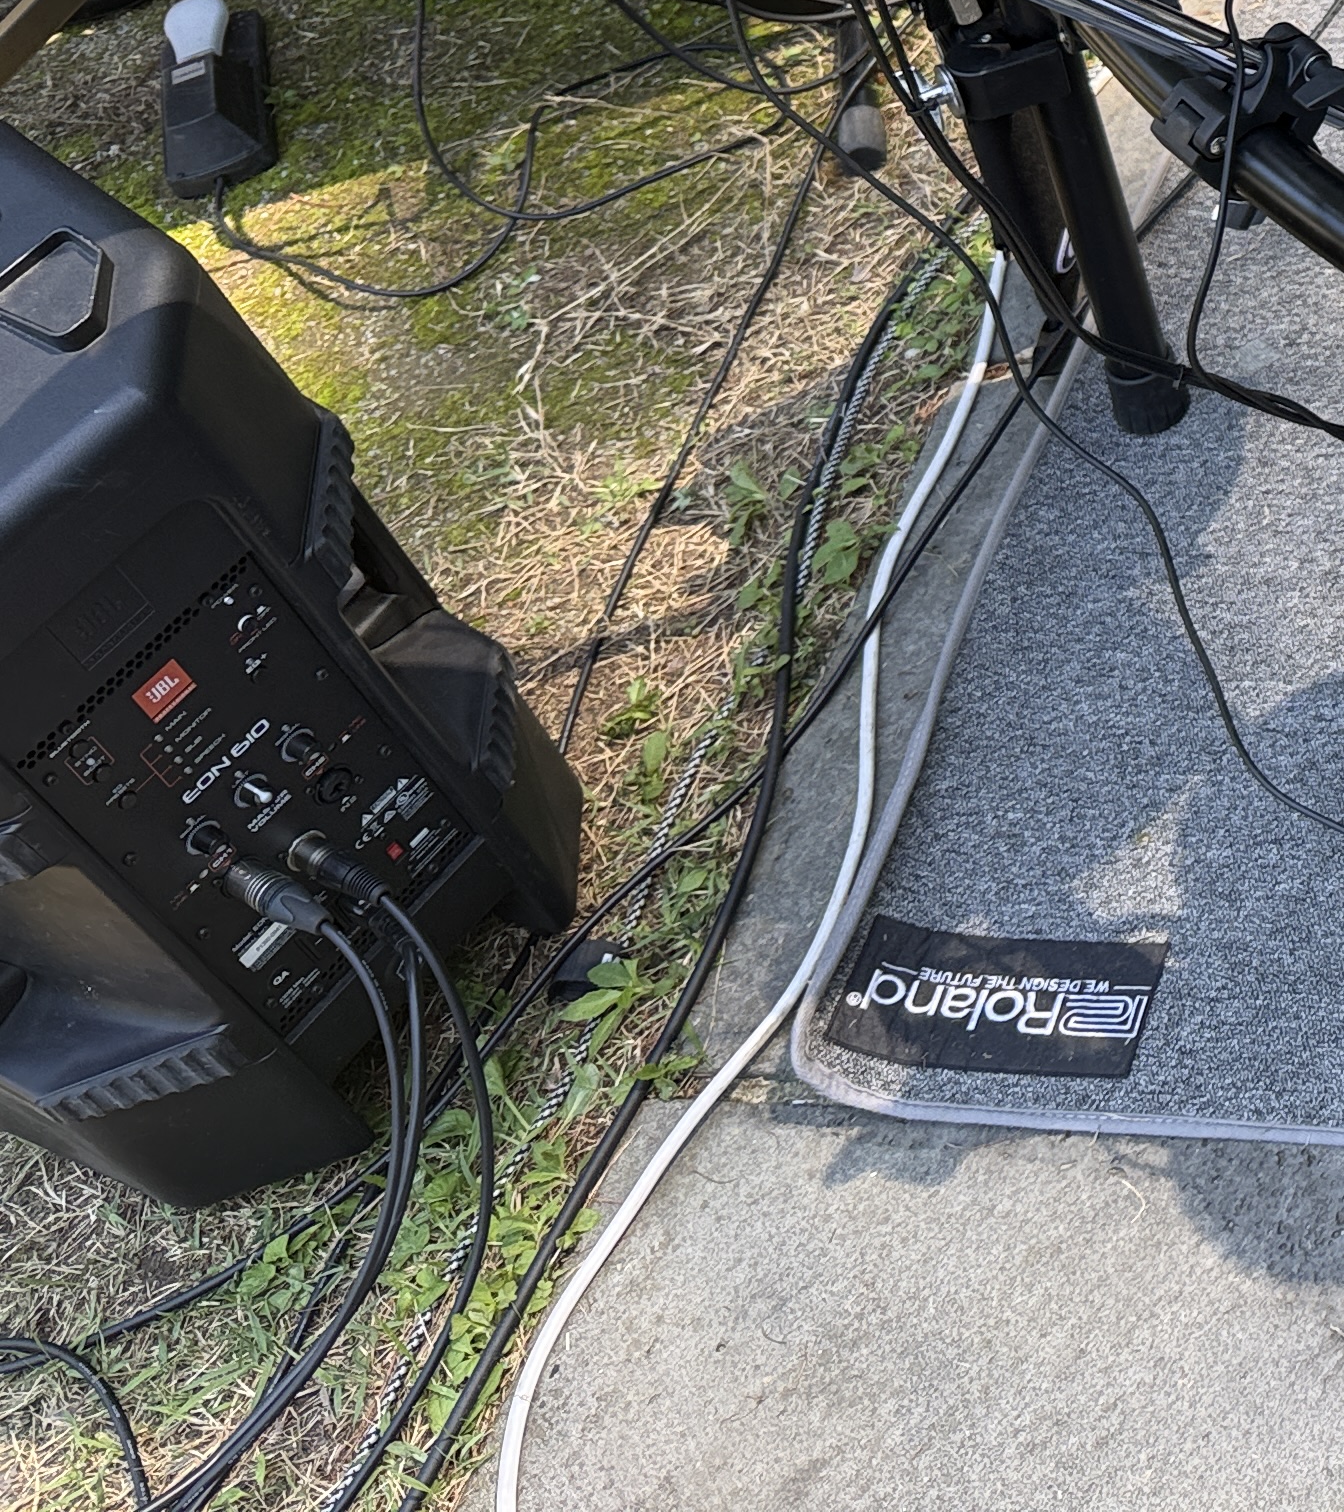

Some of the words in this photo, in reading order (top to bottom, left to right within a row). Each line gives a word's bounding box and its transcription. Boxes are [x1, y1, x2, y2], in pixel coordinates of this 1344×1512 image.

[145, 675, 180, 703] JBL
[165, 710, 187, 731] MAIN
[175, 707, 212, 742] MONITOR
[182, 755, 231, 804] EON
[230, 718, 270, 758] 610
[249, 793, 293, 832] VOLUME
[272, 970, 290, 986] QA
[919, 966, 985, 987] FUTURE
[986, 974, 1021, 990] THE
[1022, 977, 1081, 992] DESIGN
[1085, 979, 1110, 993] WE
[860, 968, 1070, 1036] Roland
